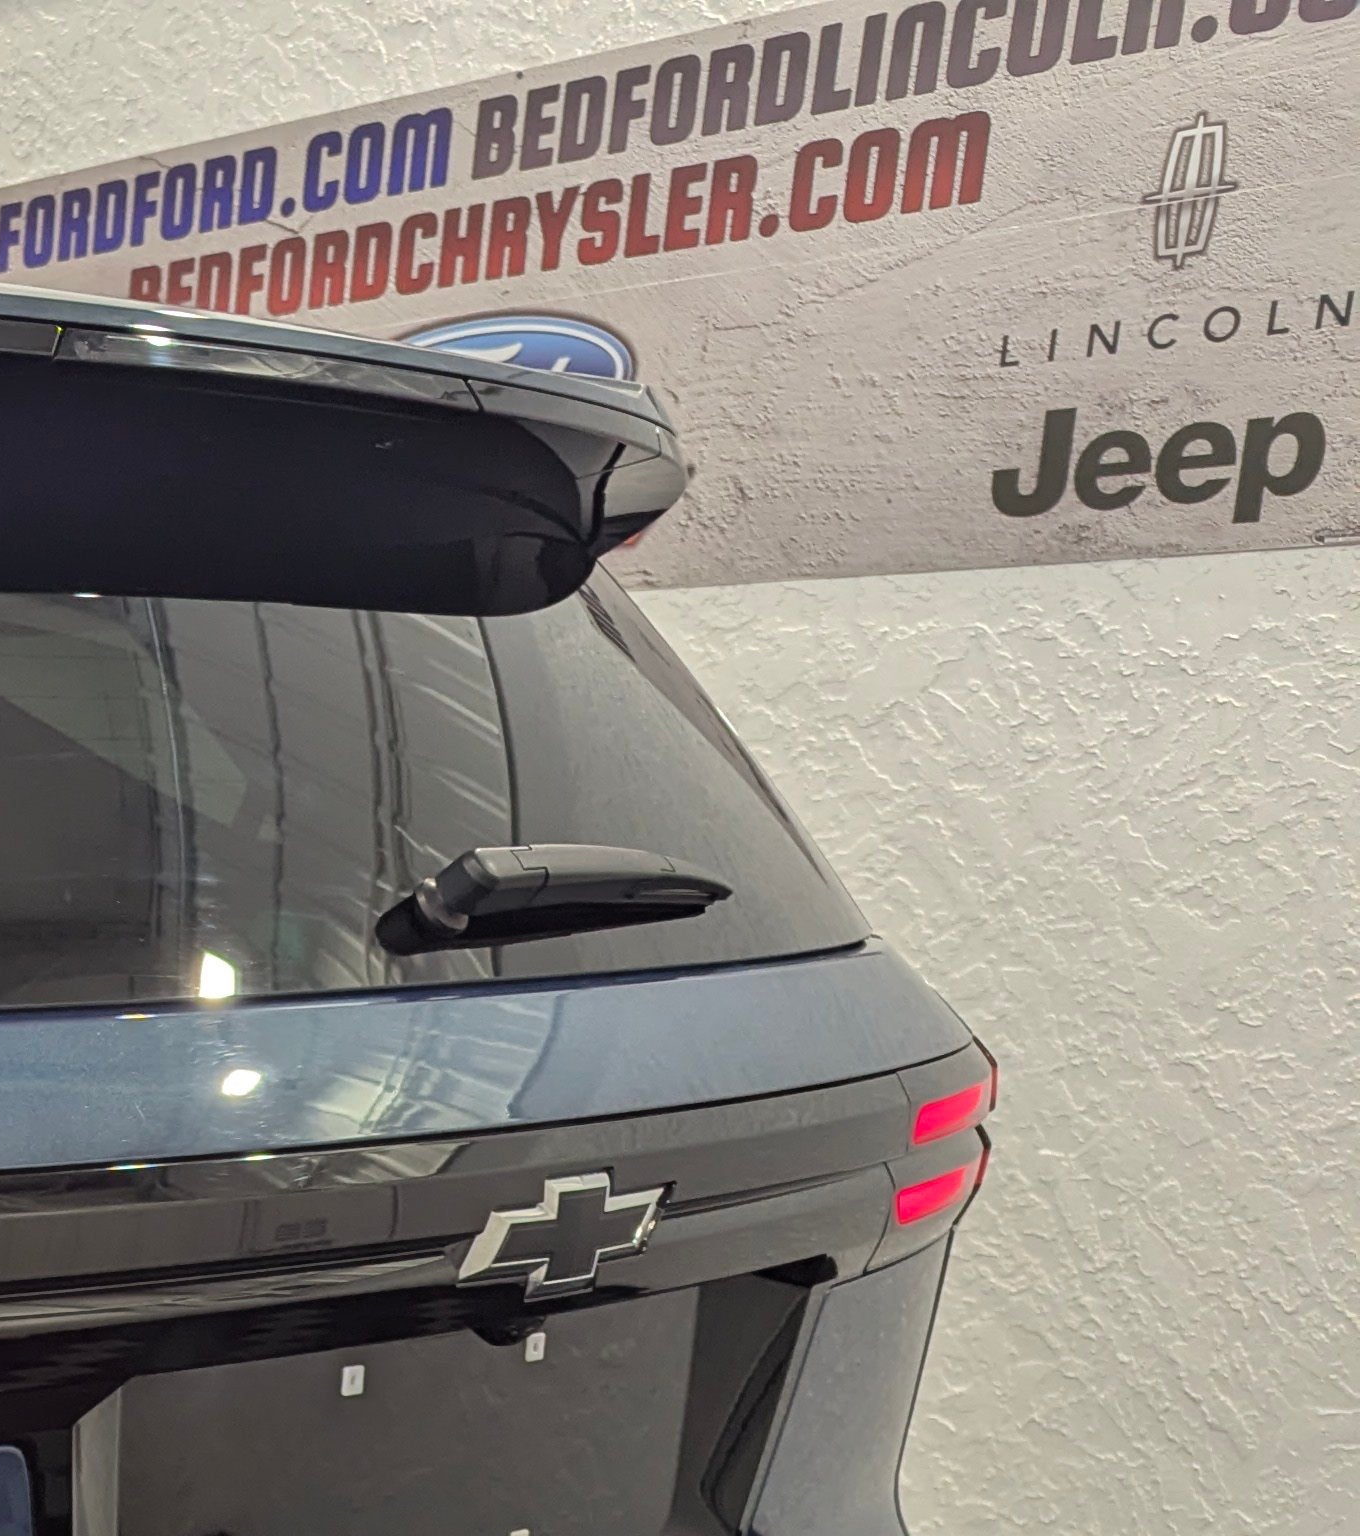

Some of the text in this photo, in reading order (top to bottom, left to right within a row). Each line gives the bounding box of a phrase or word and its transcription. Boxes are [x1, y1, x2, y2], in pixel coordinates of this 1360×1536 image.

[471, 0, 1359, 181] BEDFORDLINCOLN.
[999, 290, 1355, 368] LINCOLN
[991, 407, 1326, 524] Jeep
